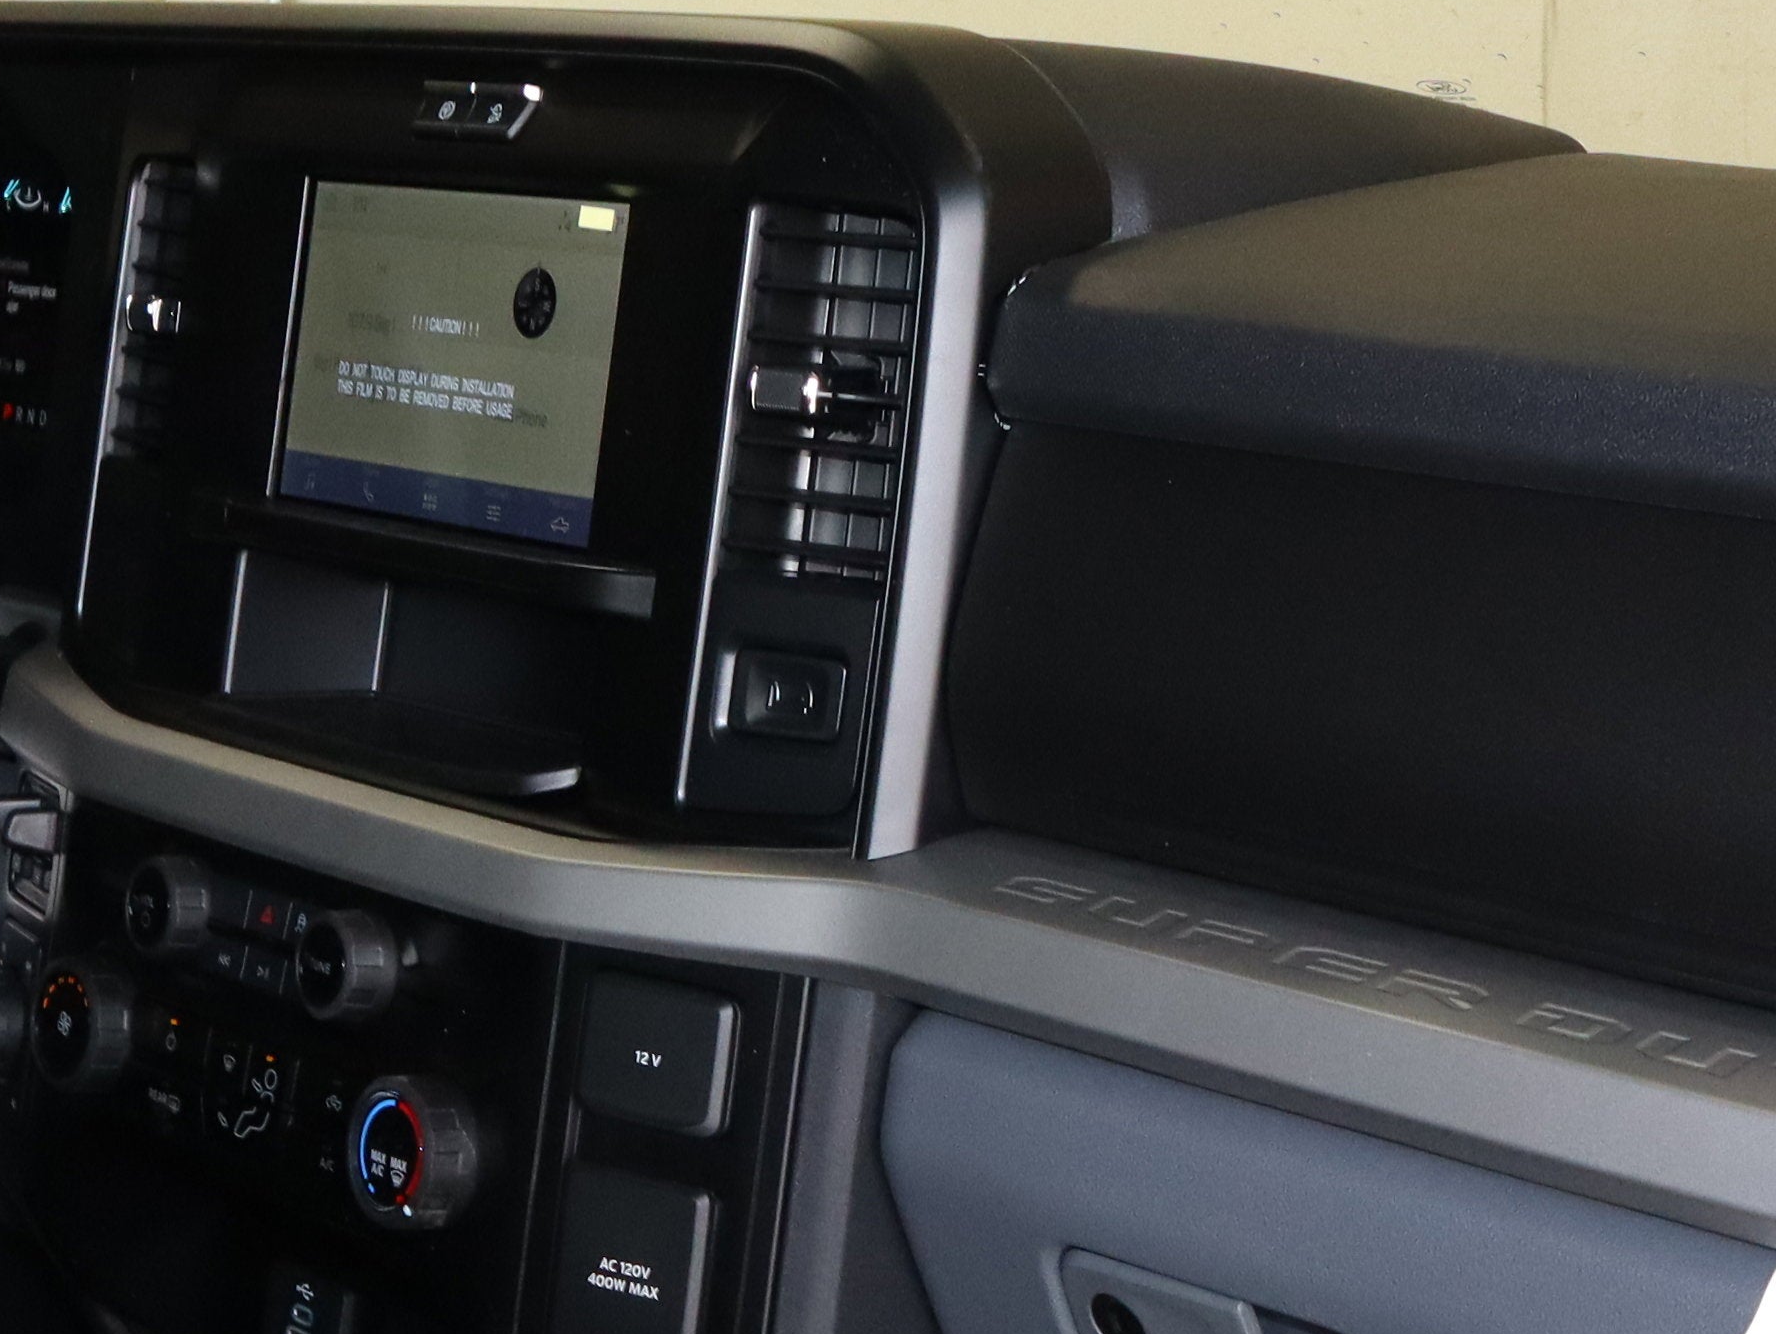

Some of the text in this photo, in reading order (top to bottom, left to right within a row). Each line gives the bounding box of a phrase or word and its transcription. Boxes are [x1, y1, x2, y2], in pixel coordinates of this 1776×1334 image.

[338, 359, 515, 399] DO NOT TOUCH DISPLAY DURING INSTALLATION
[3, 403, 13, 420] P
[15, 406, 23, 422] R
[27, 408, 35, 424] N
[337, 379, 513, 420] THIS FILM IS TO BE REMOVED BEFORE USAGE
[991, 876, 1490, 1010] SUPER
[370, 1148, 407, 1173] MAX MAX
[599, 1256, 651, 1280] AC 120V
[587, 1272, 659, 1301] 400W MAX
